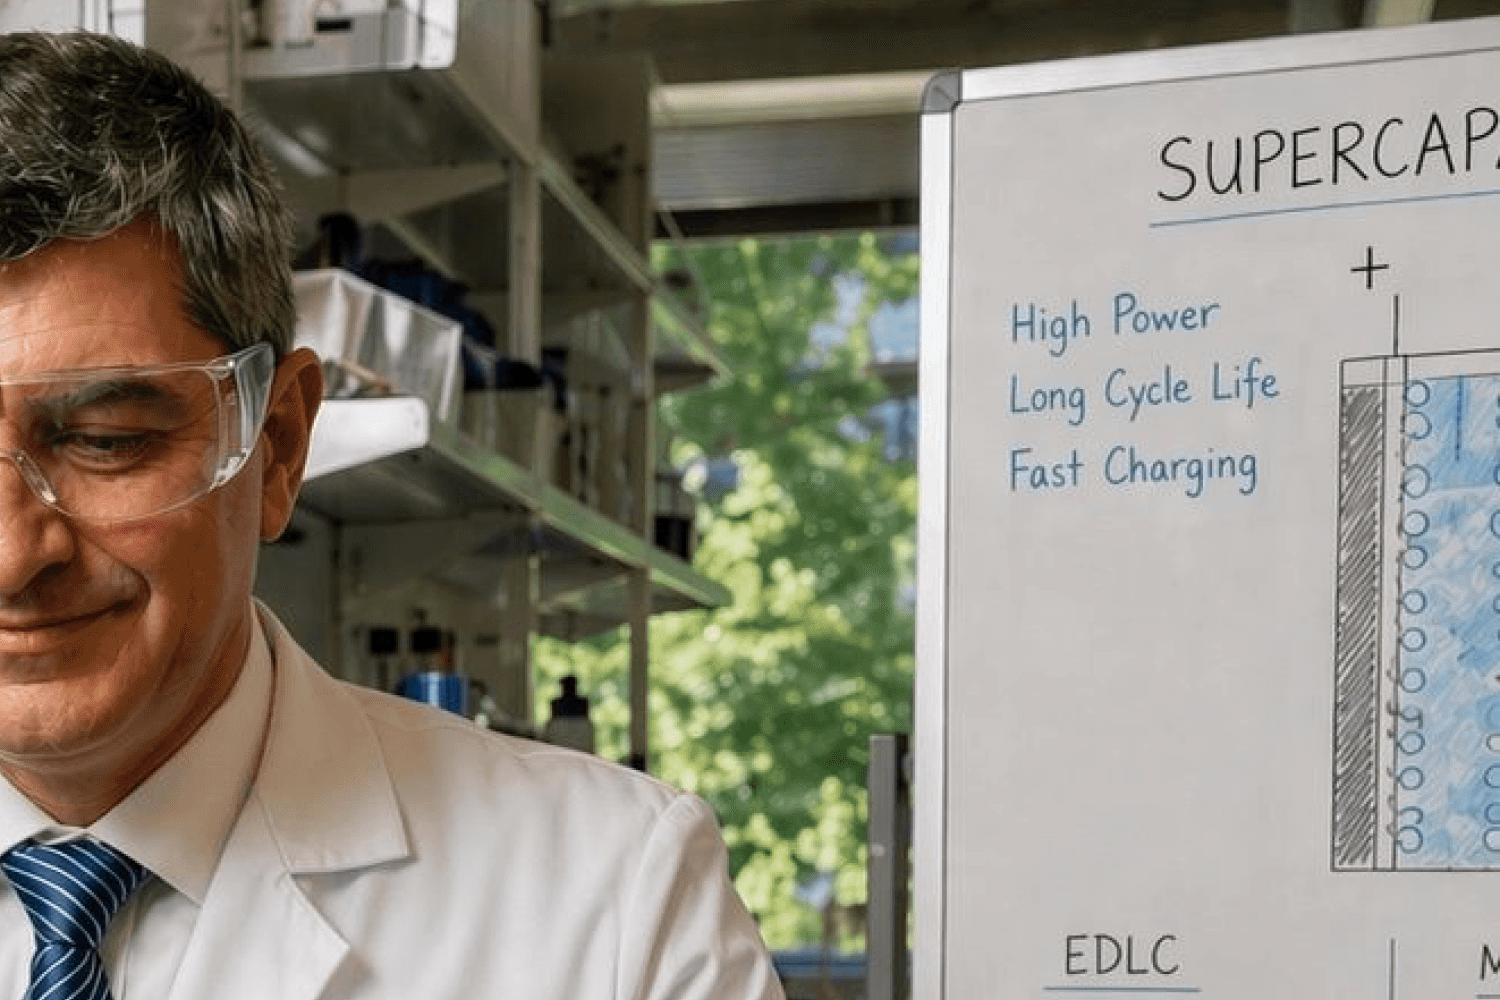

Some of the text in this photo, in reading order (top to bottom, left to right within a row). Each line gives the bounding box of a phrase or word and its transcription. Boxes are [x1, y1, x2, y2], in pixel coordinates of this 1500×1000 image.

[1158, 108, 1500, 201] SUPERCAP
[1013, 293, 1219, 357] High Power
[1011, 357, 1280, 426] Long Cycle Life
[1012, 446, 1256, 498] Fast Charging
[1067, 935, 1178, 974] EDLC
